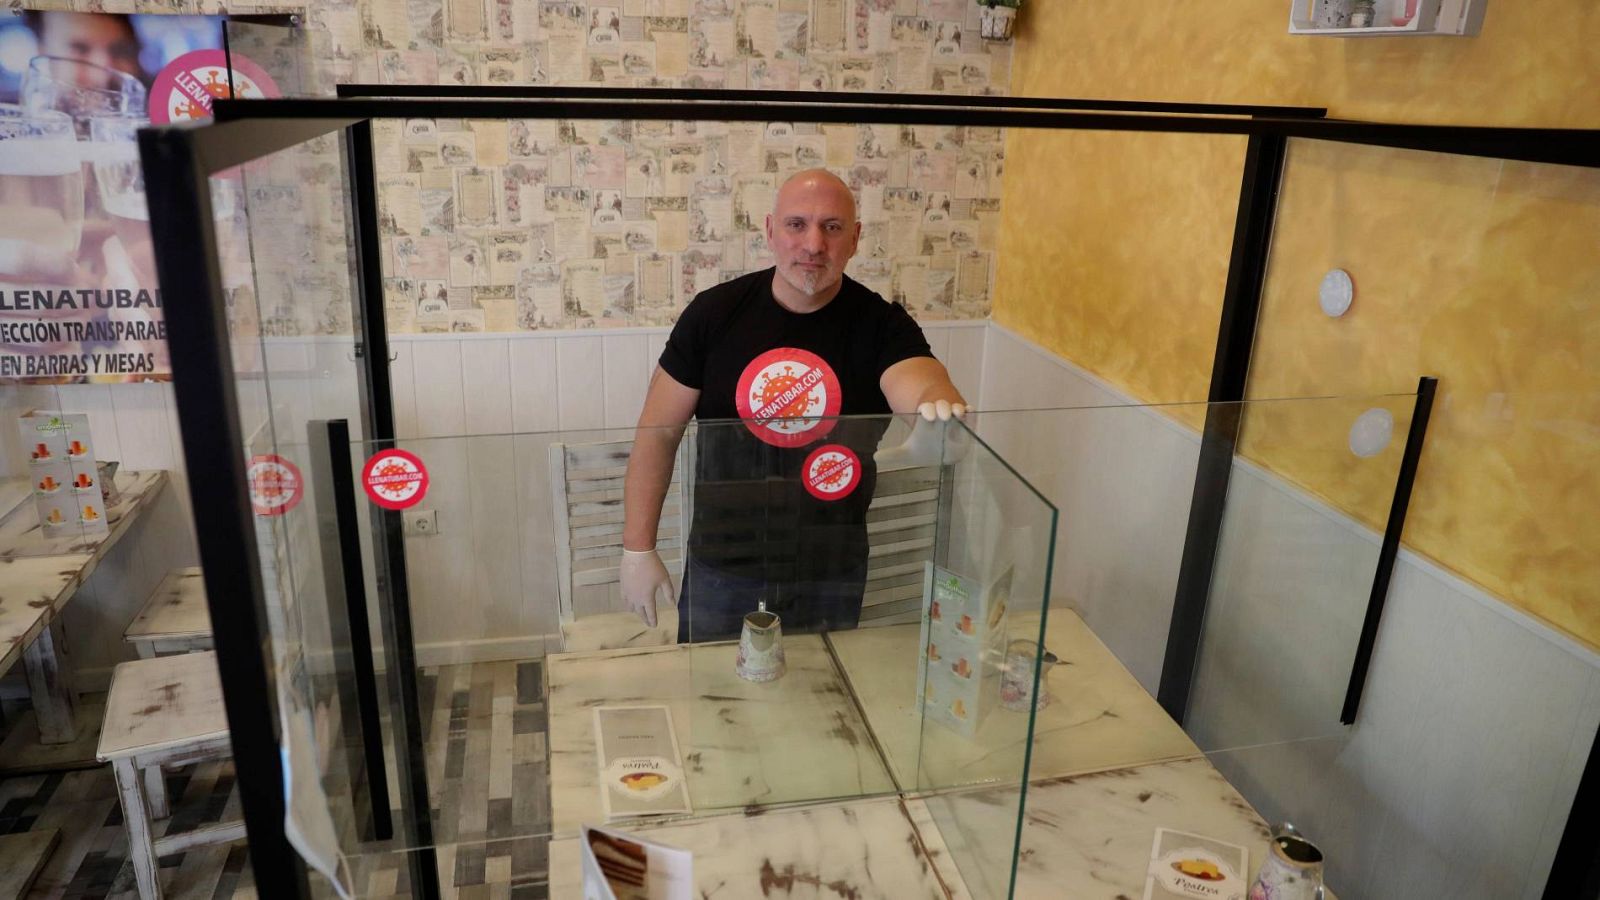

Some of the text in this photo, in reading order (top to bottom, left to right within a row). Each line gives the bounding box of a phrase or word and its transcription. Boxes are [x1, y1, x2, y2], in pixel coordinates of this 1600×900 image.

[1, 353, 154, 376] EN BARRAS Y MESAS
[755, 367, 824, 425] LLENATUBAR.COM
